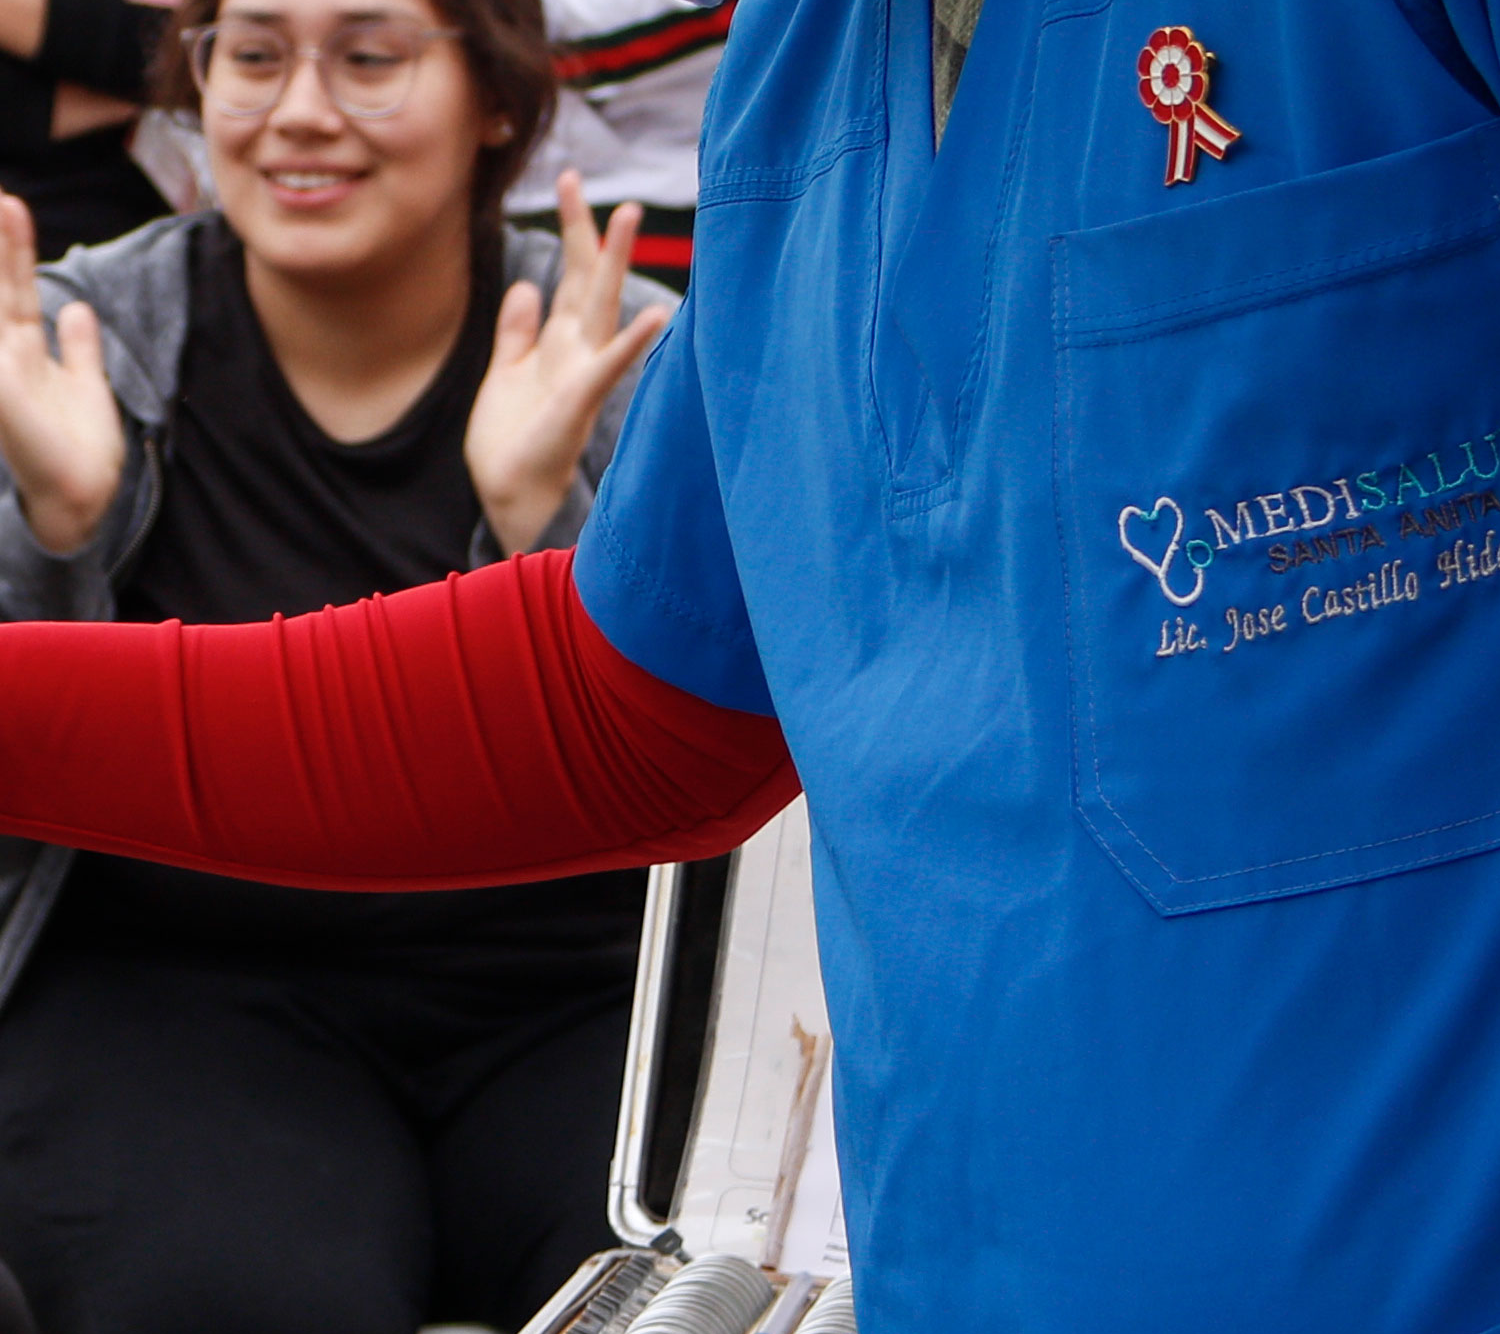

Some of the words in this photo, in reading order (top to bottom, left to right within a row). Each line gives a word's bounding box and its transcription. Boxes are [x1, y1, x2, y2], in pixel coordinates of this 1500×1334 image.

[1268, 524, 1386, 574] SANTA
[1156, 616, 1208, 657] Lic.
[1222, 603, 1288, 653] Jose
[1301, 560, 1420, 625] Castillo
